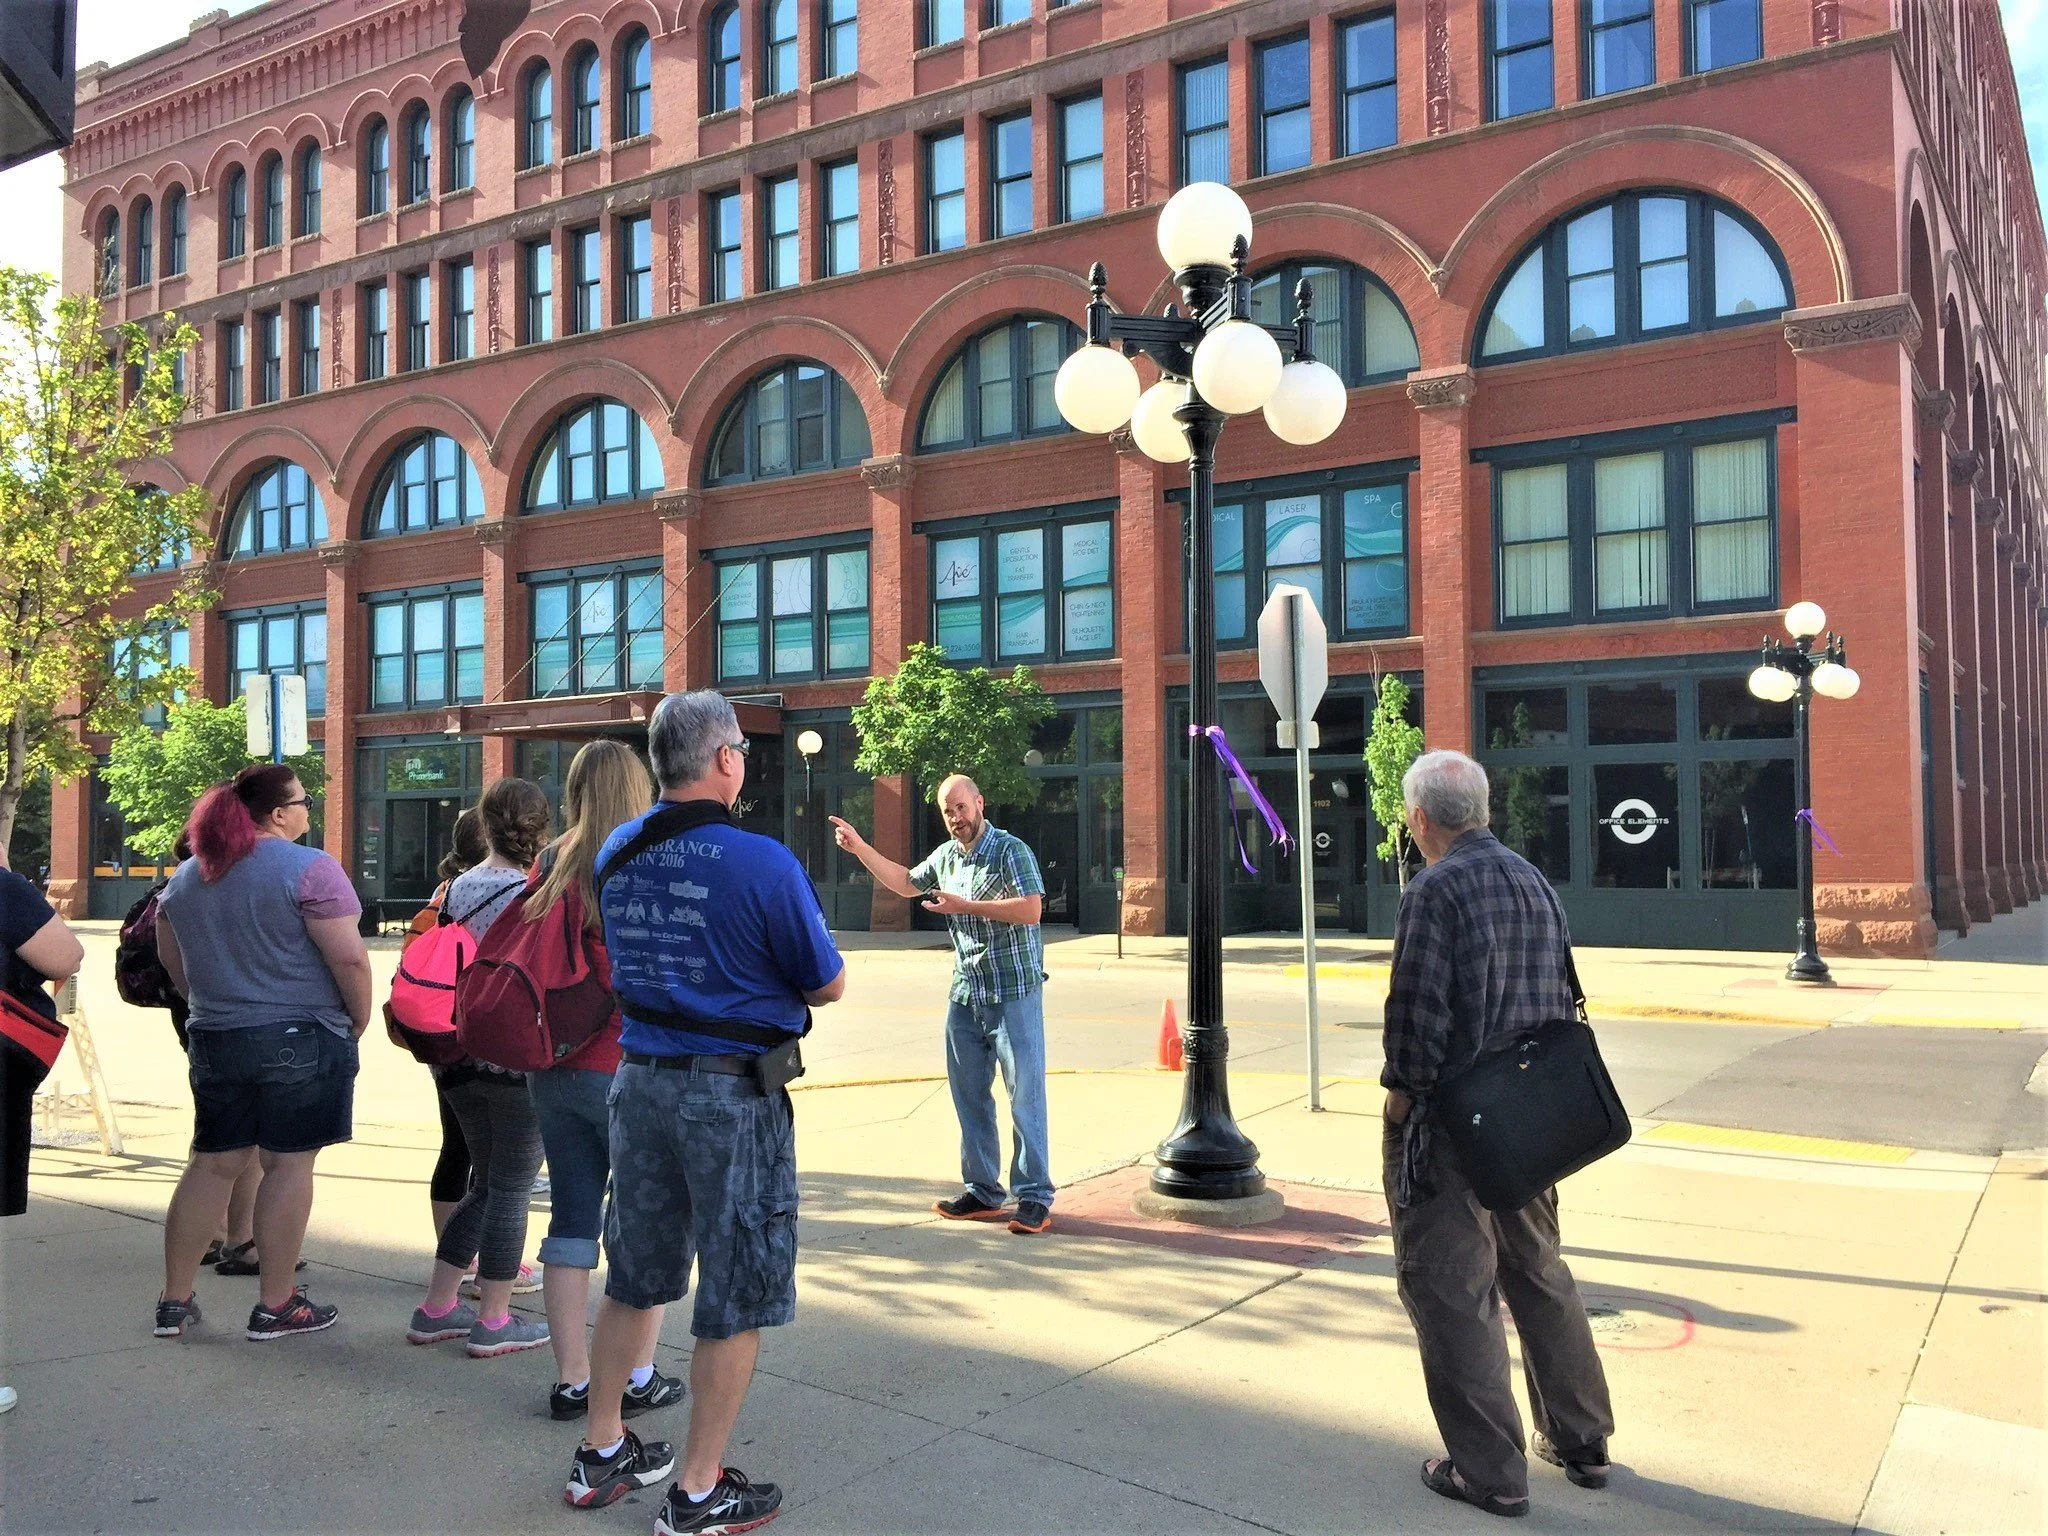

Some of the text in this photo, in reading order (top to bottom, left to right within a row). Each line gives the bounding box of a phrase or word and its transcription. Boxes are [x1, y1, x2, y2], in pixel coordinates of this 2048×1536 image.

[1364, 494, 1381, 504] SPA
[1279, 503, 1307, 515] LASER
[1212, 512, 1236, 523] DICAL
[1073, 539, 1098, 547] MEDICAL
[1009, 546, 1031, 556] GENTLE
[1087, 547, 1099, 555] DIET
[1003, 553, 1039, 563] LIPOSUCTION
[1007, 573, 1034, 582] TRANSFER
[1069, 602, 1084, 611] CHIN
[1092, 600, 1107, 609] NECK
[1071, 608, 1105, 618] TIGHTENING
[1071, 624, 1106, 635] SILHOUETTE
[1016, 631, 1029, 639] HAIR
[1006, 638, 1040, 648] TRANSPLANT
[1313, 799, 1331, 808] 1102
[1628, 817, 1670, 825] ELEMENTS
[658, 853, 686, 869] 2016
